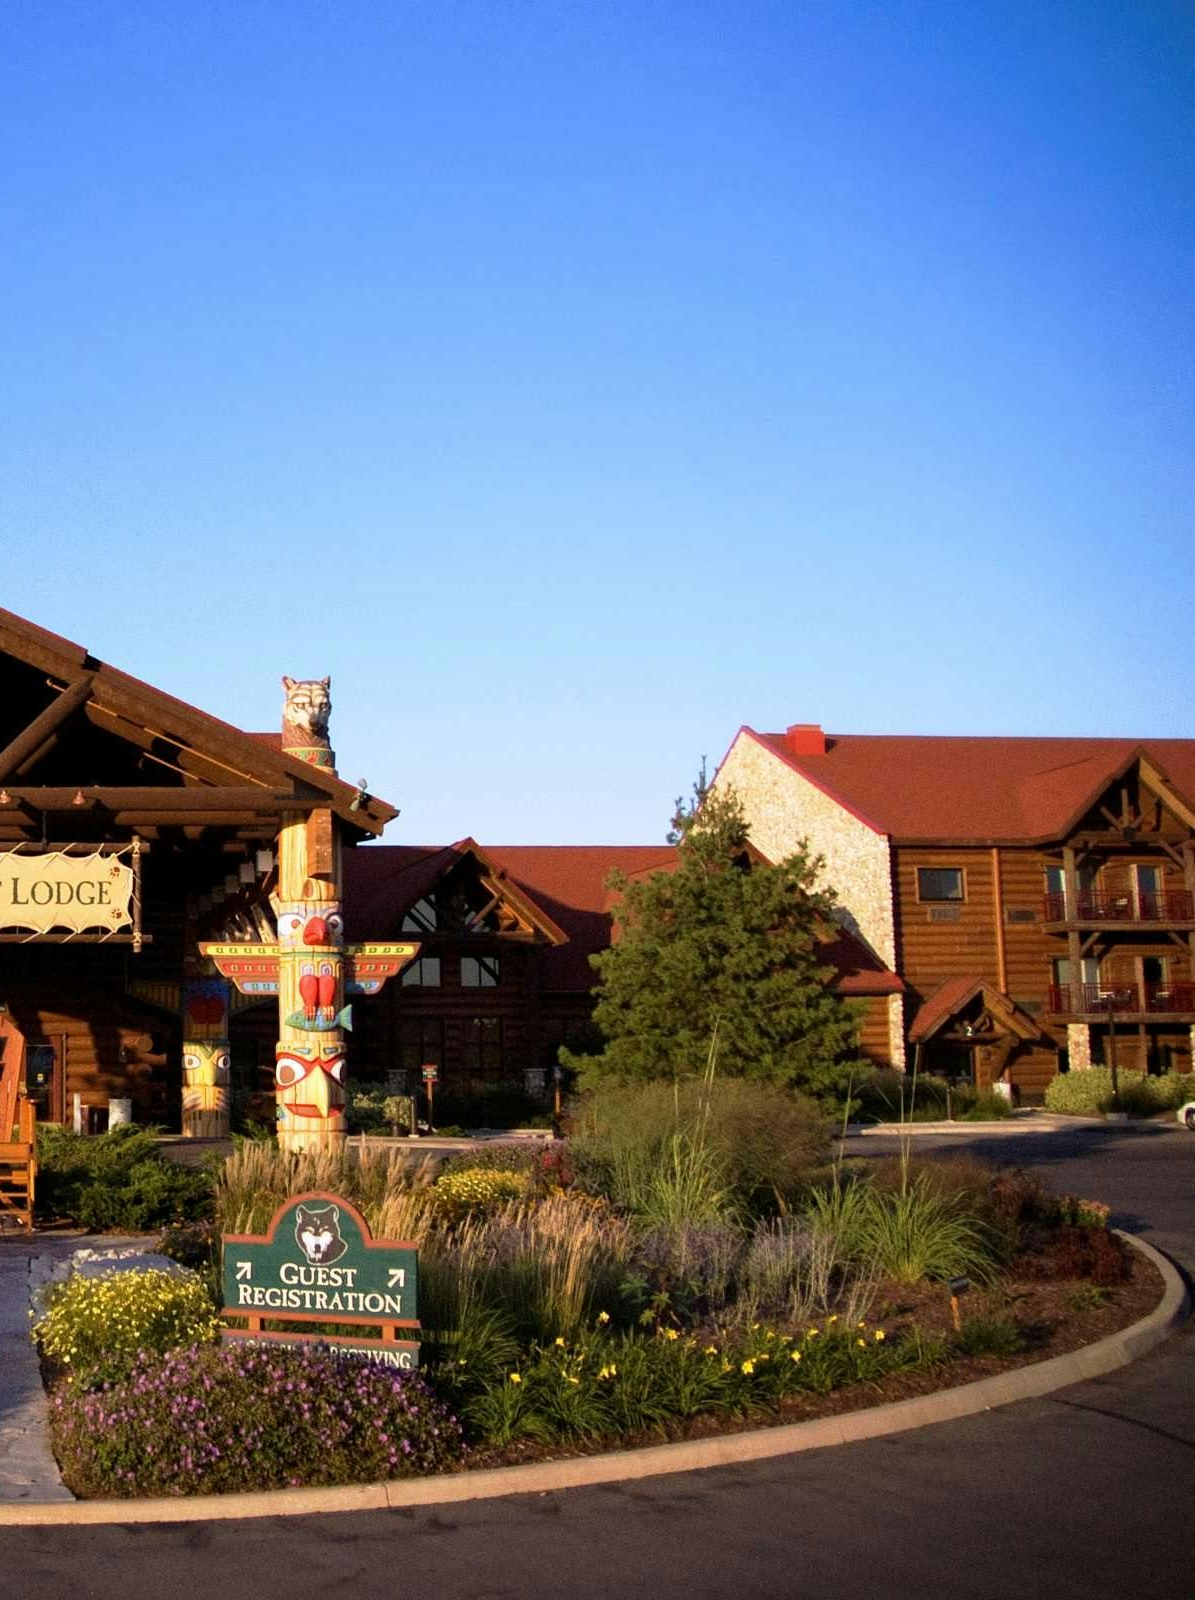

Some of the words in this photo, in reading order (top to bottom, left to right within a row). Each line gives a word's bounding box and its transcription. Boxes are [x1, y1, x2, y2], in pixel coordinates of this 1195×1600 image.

[11, 877, 112, 905] LODGE
[965, 1026, 973, 1037] 2
[279, 1263, 357, 1288] GUEST
[238, 1284, 402, 1314] REGISTRATION
[330, 1346, 411, 1369] RIVING
